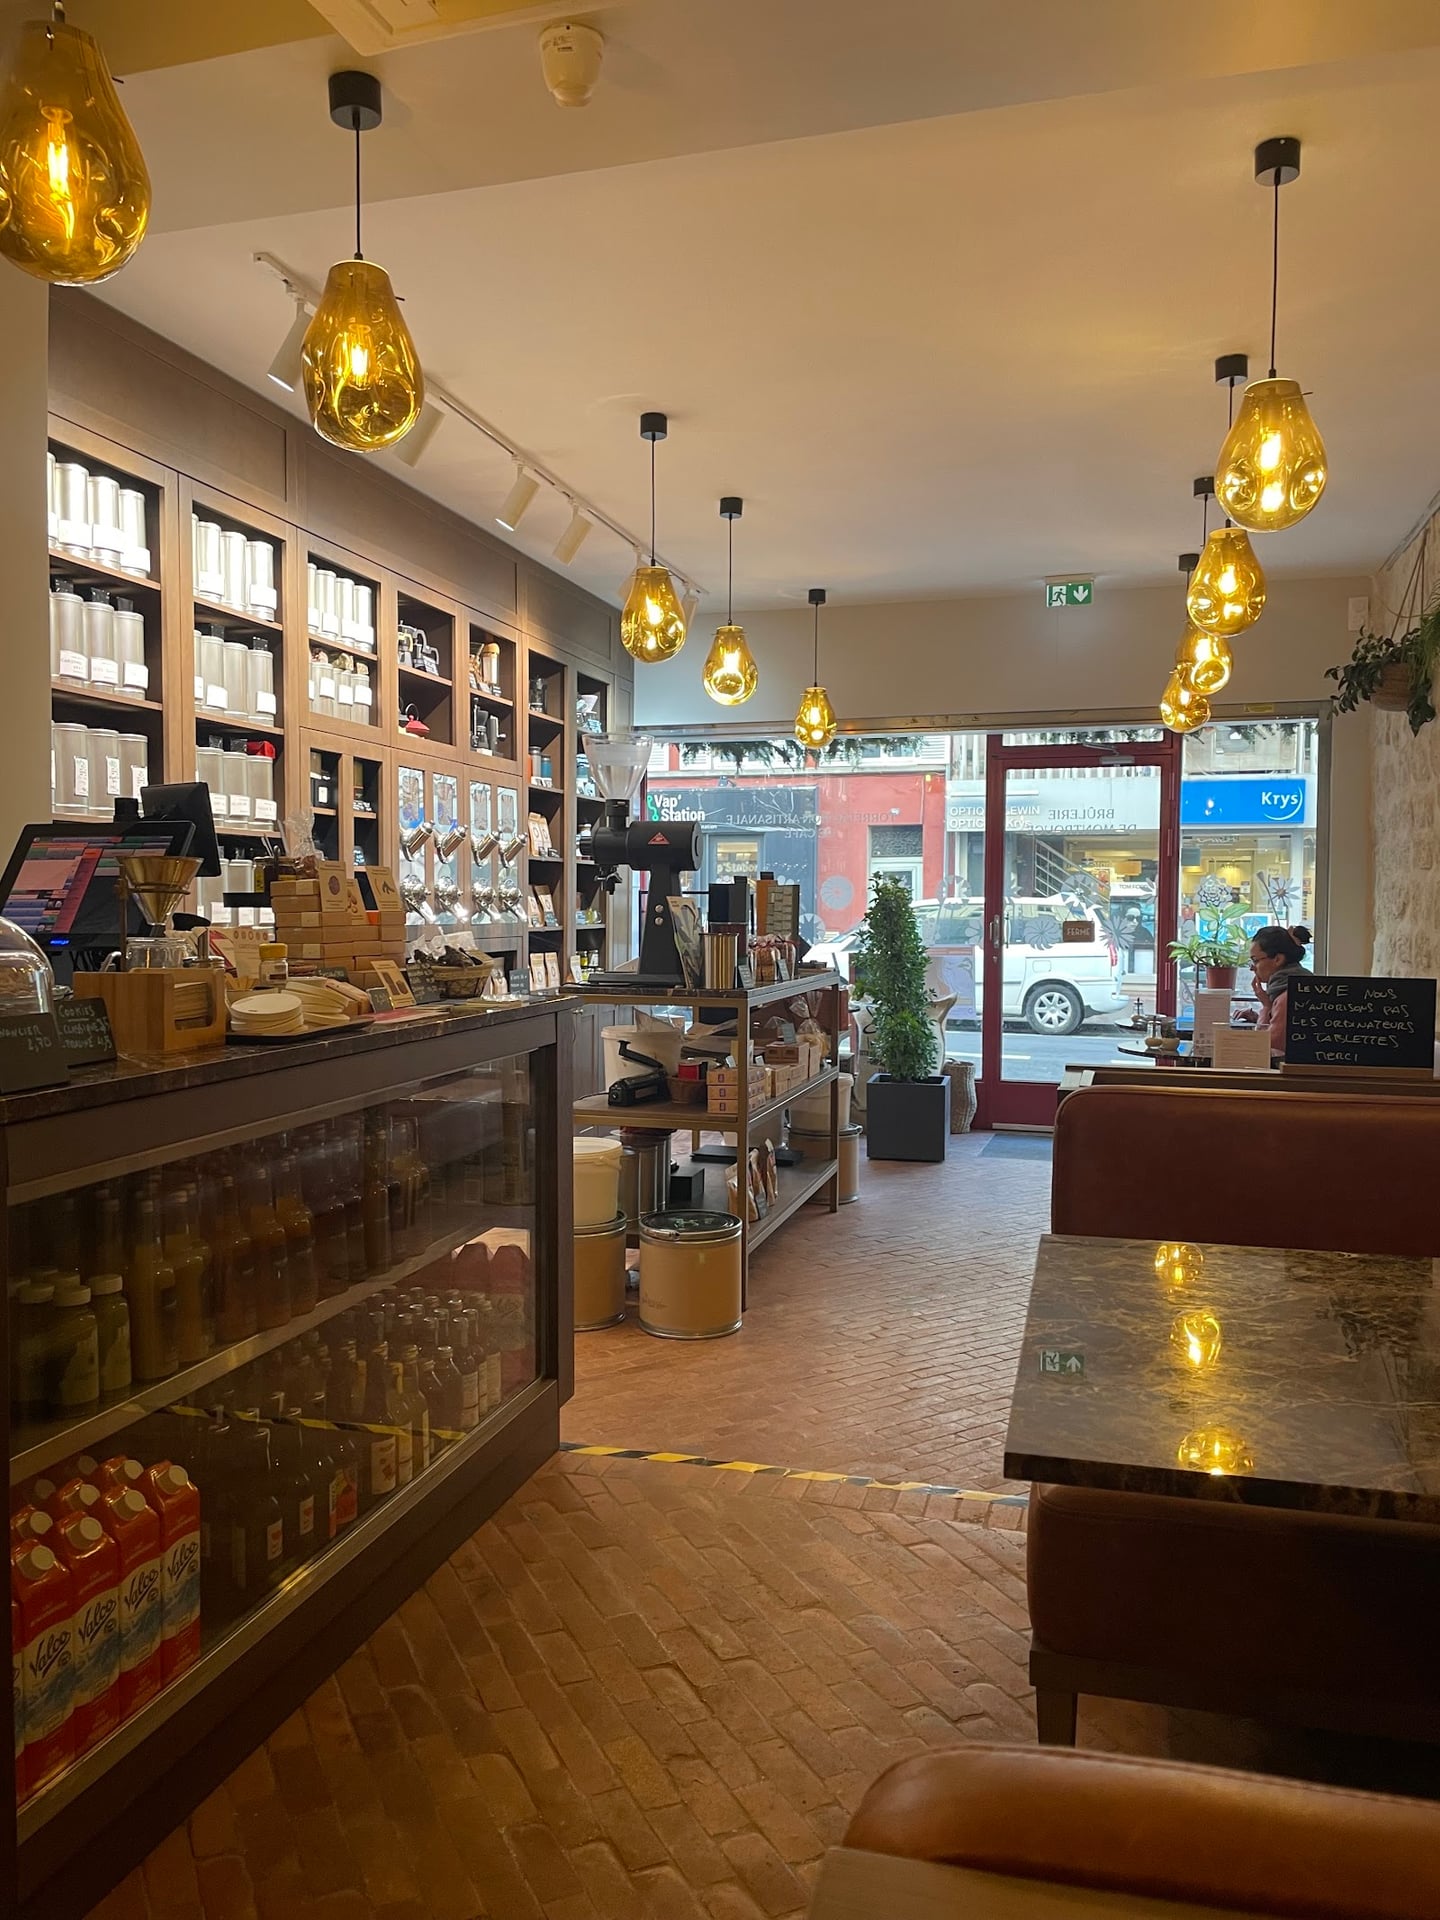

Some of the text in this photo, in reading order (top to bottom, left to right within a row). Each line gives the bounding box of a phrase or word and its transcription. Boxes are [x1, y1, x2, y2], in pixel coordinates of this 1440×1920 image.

[654, 794, 682, 814] Vap'
[1261, 791, 1301, 809] Krys
[661, 808, 706, 821] Station
[950, 806, 985, 817] OPTIQ
[950, 818, 985, 829] OPTIC
[1363, 988, 1398, 1000] NOUS
[1383, 1004, 1410, 1018] PAS
[1292, 1016, 1415, 1034] LES ORDINATEURS
[1313, 1032, 1400, 1049] TABLETTES
[1315, 1051, 1359, 1063] MERCI
